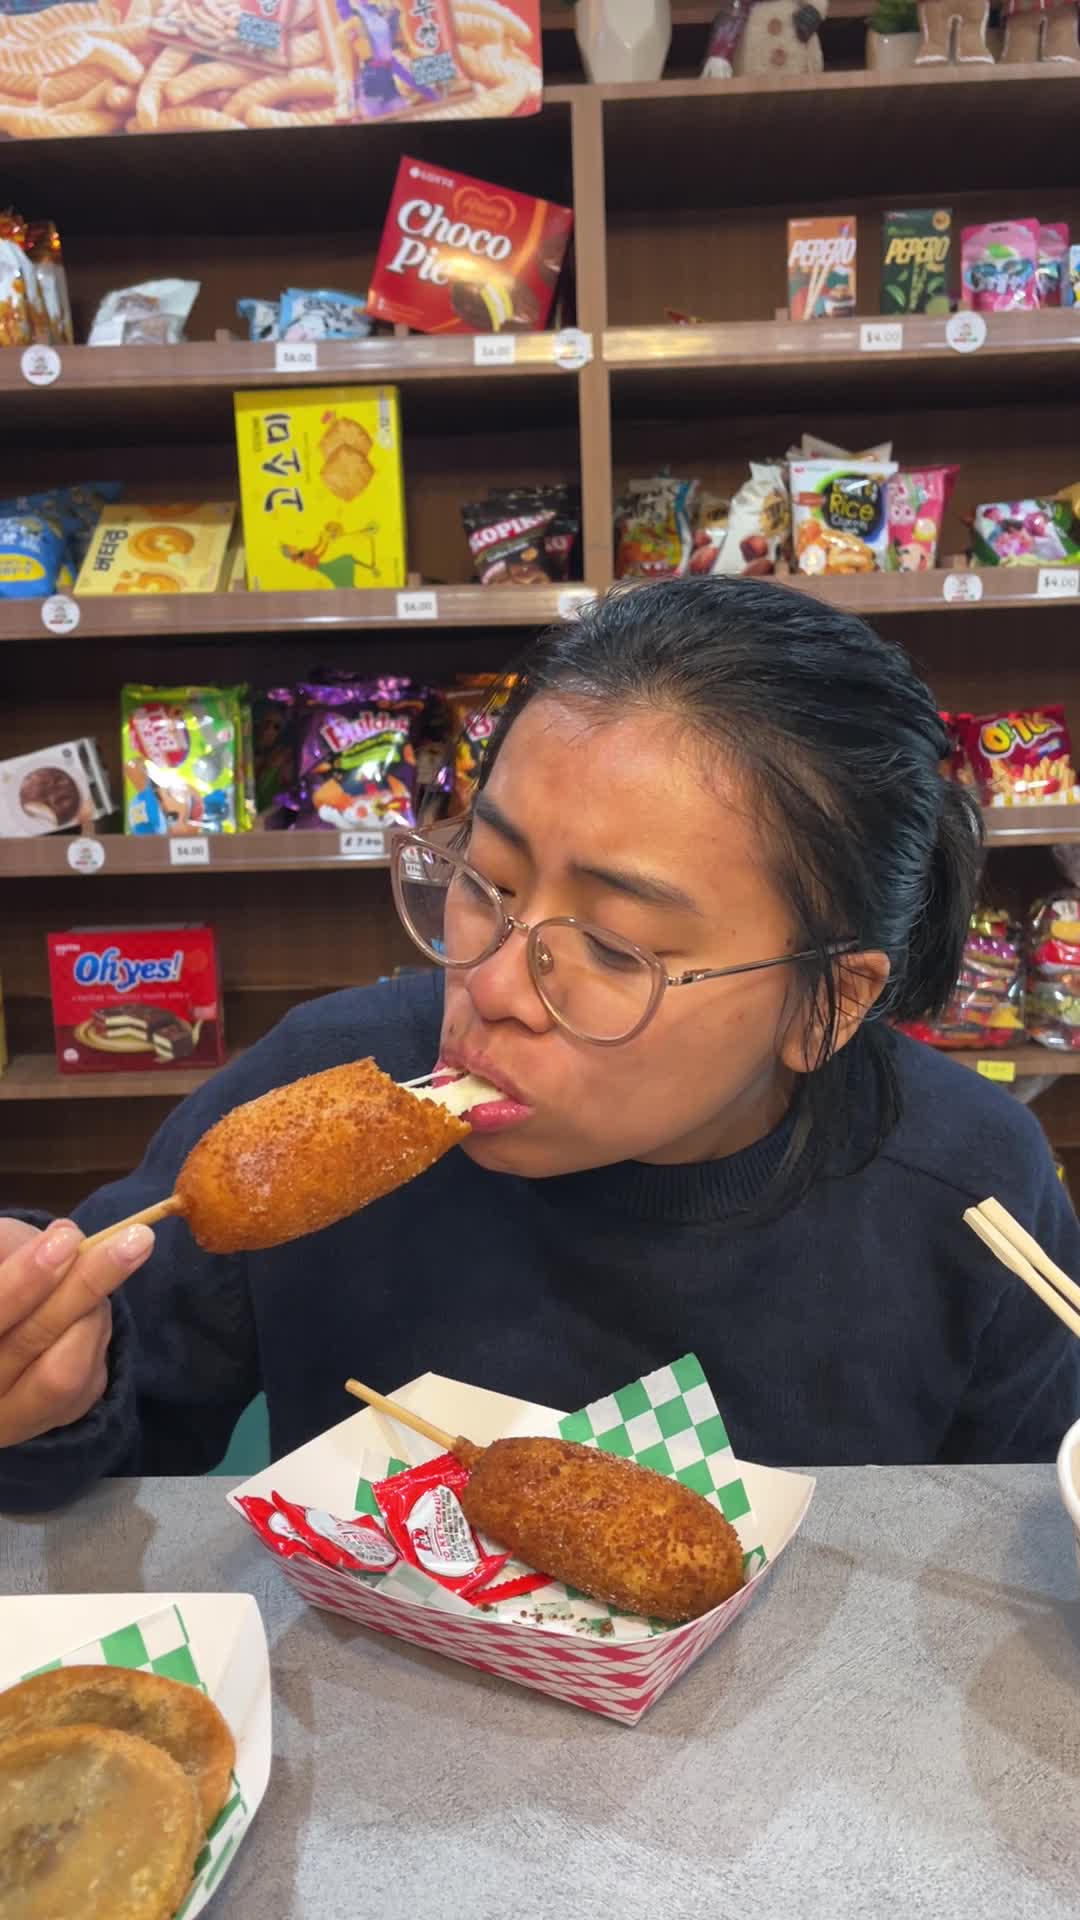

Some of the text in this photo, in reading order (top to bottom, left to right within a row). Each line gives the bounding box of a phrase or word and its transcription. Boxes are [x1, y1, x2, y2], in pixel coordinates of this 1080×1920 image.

[397, 199, 512, 260] Choco
[884, 236, 950, 265] PEPERO
[386, 237, 449, 285] Pie
[788, 237, 857, 268] PEPERO
[261, 413, 304, 512] 고소미
[830, 493, 875, 521] Rice
[92, 529, 129, 572] 버터링
[432, 1488, 448, 1547] KETCHUP
